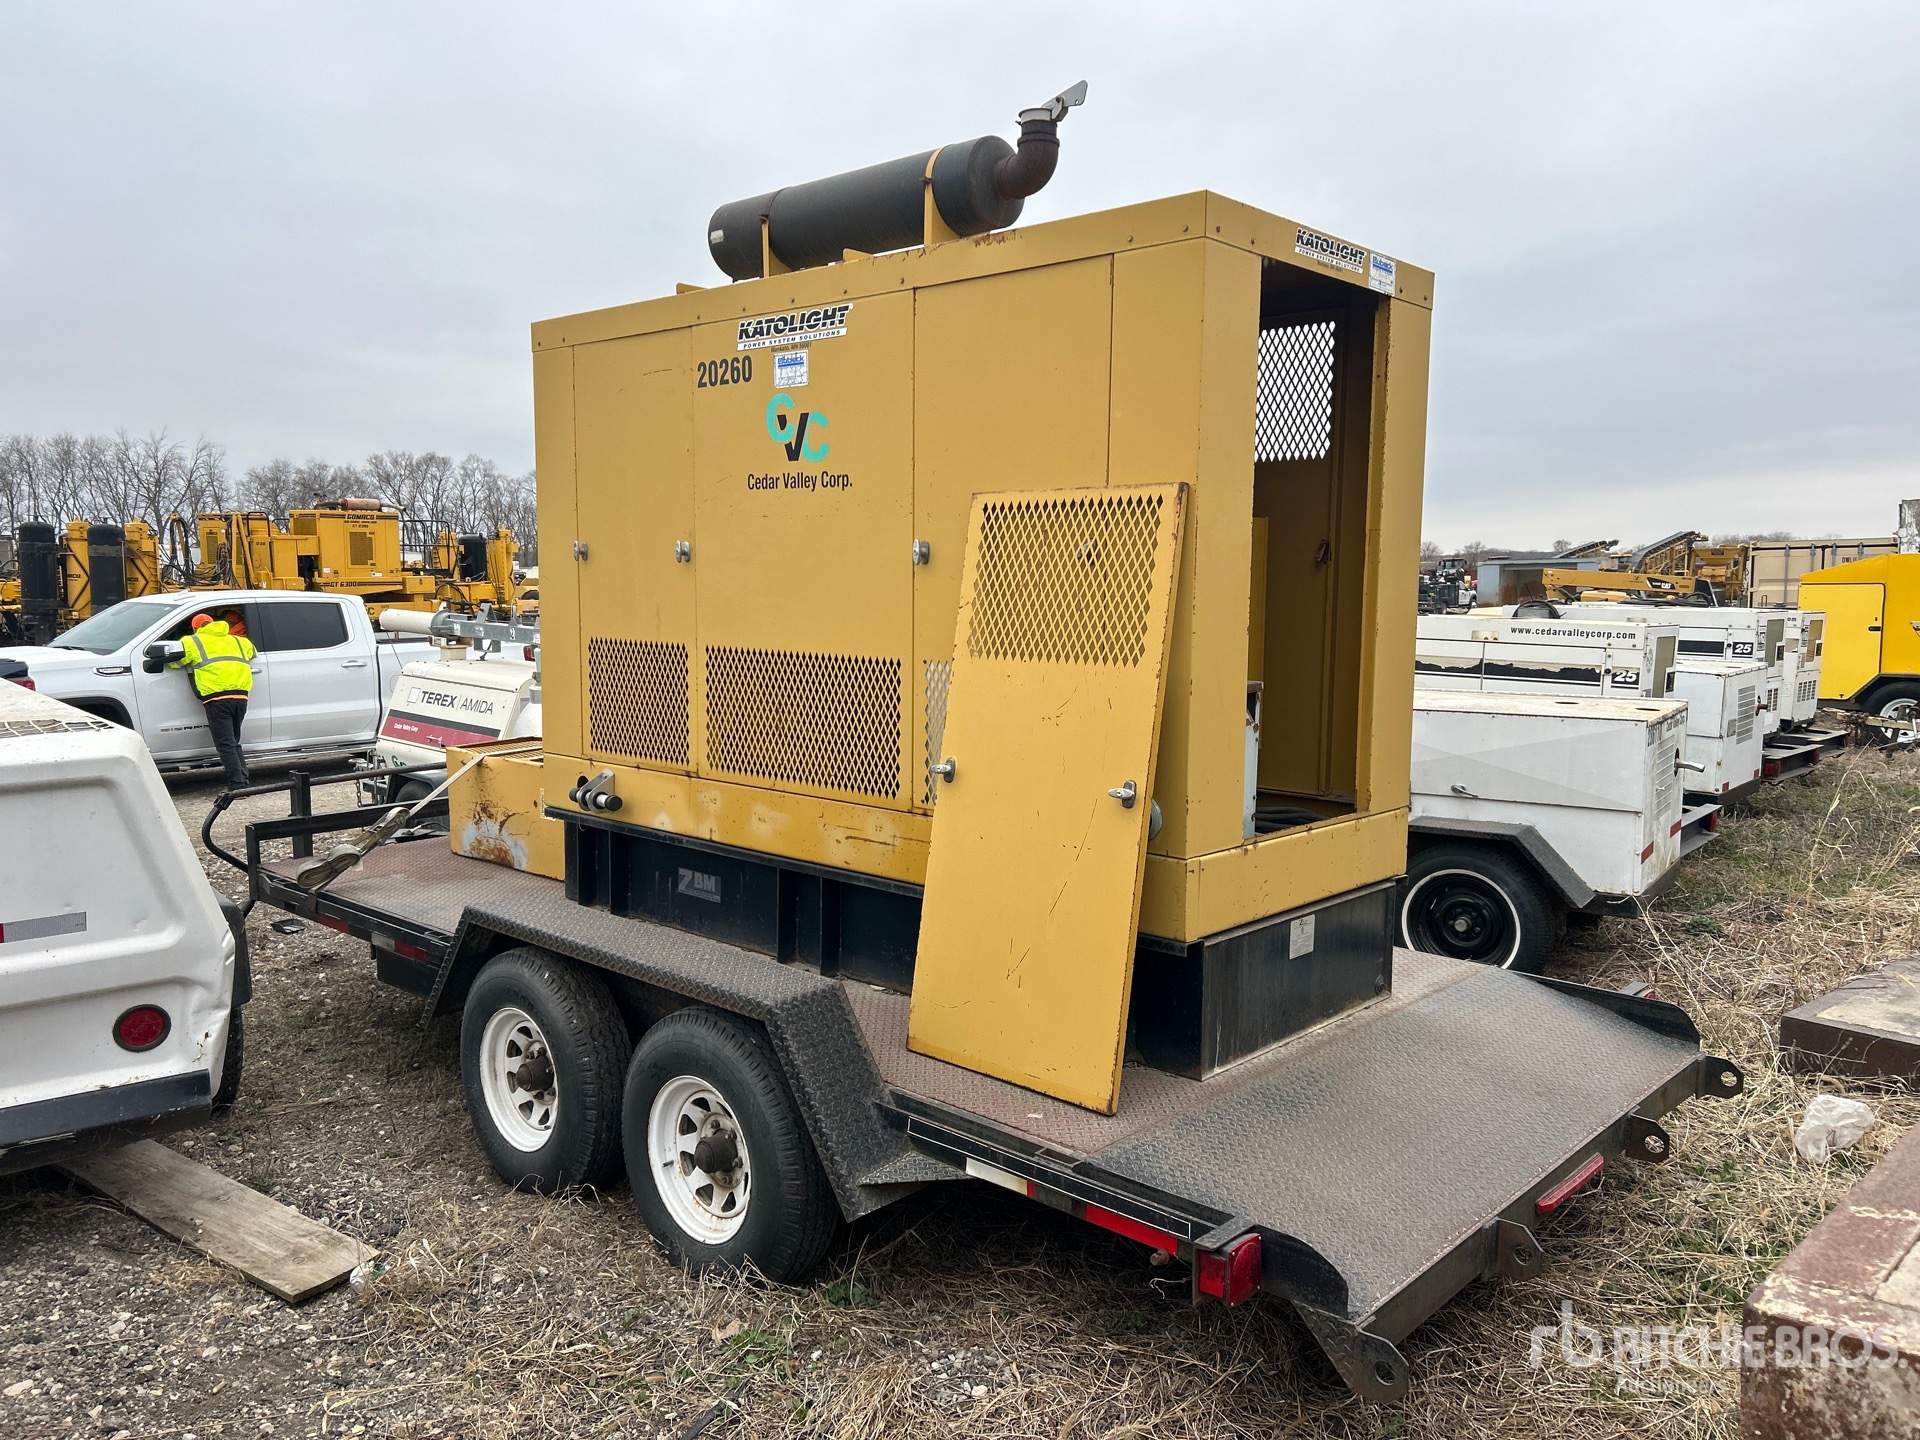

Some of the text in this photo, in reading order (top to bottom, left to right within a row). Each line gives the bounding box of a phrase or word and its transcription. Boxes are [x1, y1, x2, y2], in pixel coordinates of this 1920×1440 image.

[1296, 228, 1365, 265] KATOLIGHT
[738, 305, 849, 340] KATOLIGHT
[743, 330, 841, 349] POWER SYSTEM SOLUTIONS
[697, 355, 752, 388] 20260
[766, 393, 830, 462] CVC
[747, 471, 853, 492] Cedar Valley Corp.
[1510, 626, 1637, 640] www.cedarvalleycorp.com
[1733, 643, 1752, 654] 25
[1613, 669, 1637, 683] 25
[421, 691, 494, 715] TEREX AMIDA
